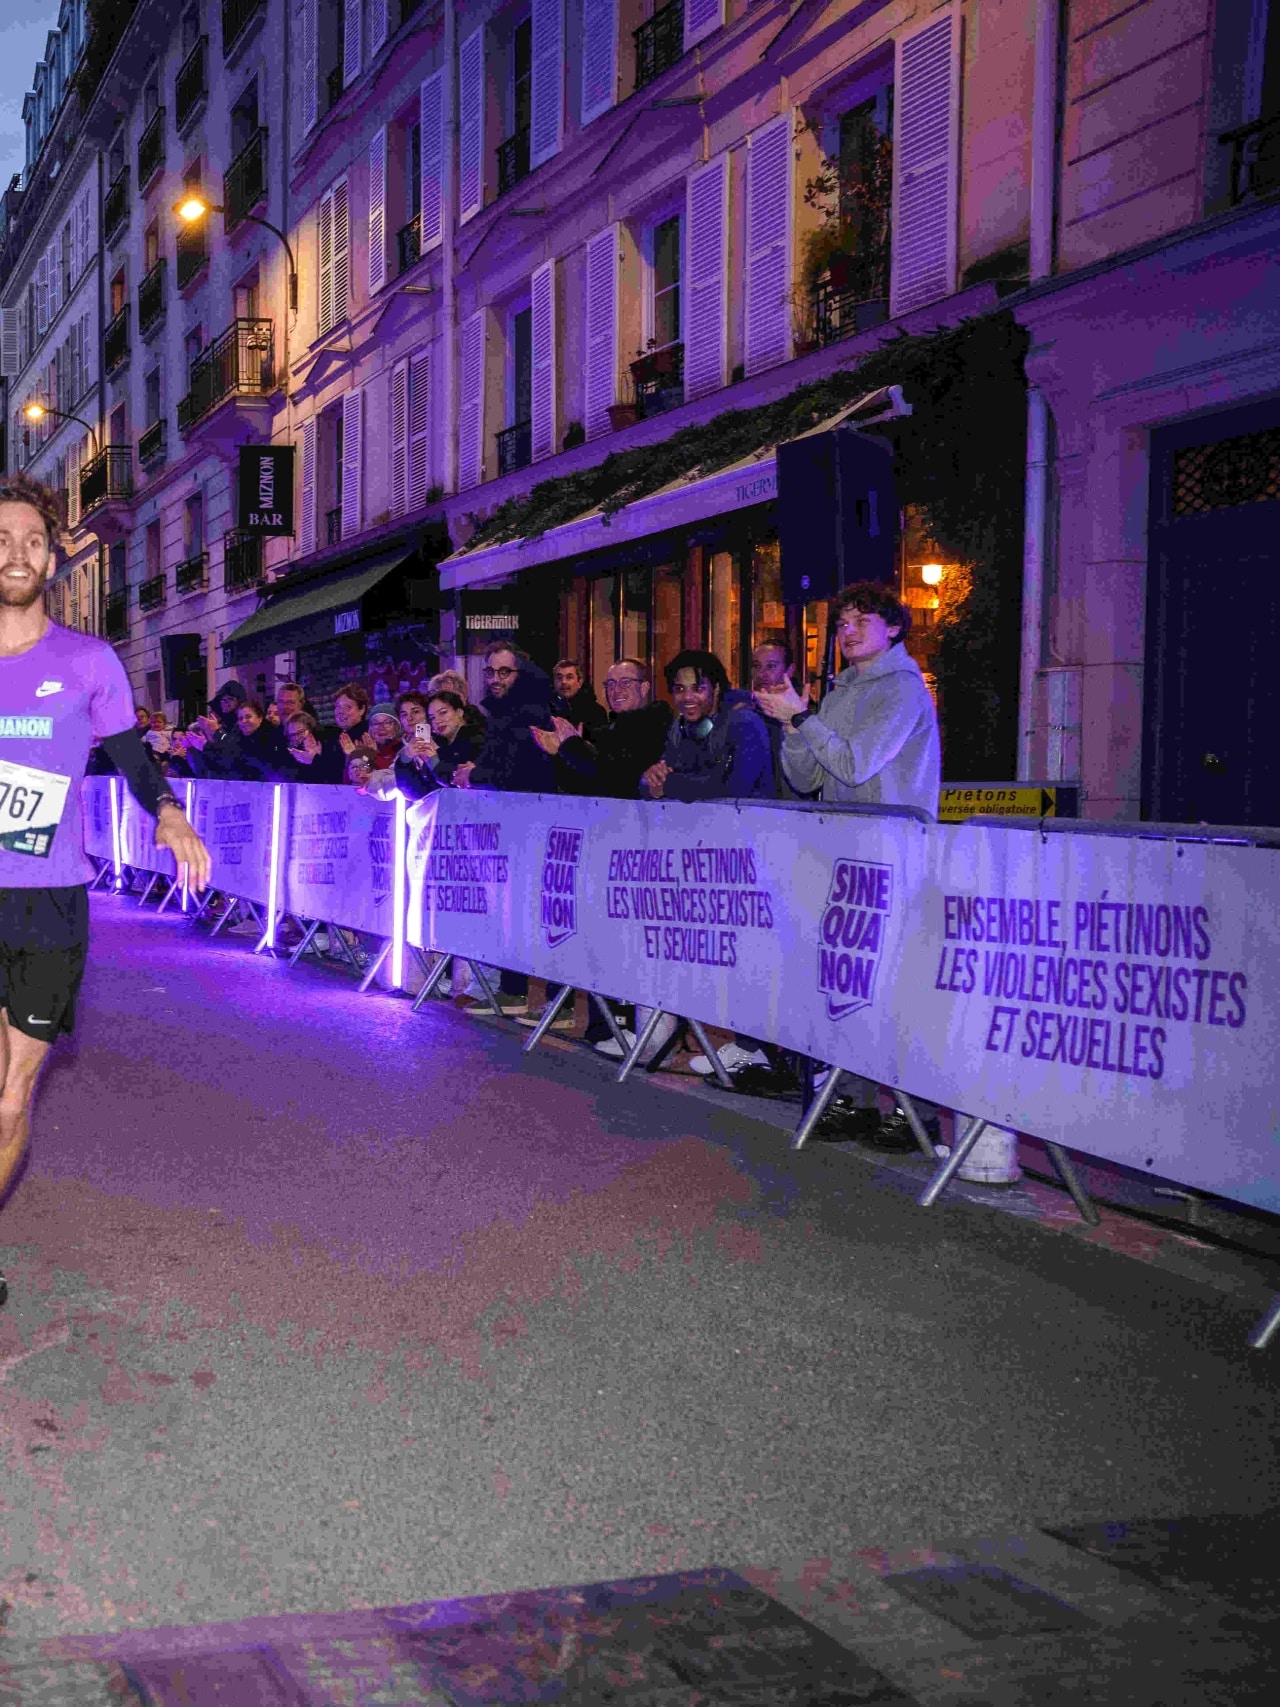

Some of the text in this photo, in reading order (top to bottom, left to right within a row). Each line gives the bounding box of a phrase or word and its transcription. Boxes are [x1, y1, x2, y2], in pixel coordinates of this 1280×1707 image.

[259, 456, 274, 509] MIZNON
[249, 513, 283, 526] BAR
[978, 803, 1037, 815] obligatoire
[546, 830, 582, 863] SINE
[608, 840, 758, 889] ENSEMBLE, PIÉTINONS
[437, 884, 488, 914] SEXUELLES
[543, 863, 575, 896] QUA
[831, 863, 890, 911] SINE
[542, 896, 575, 930] NON
[606, 886, 775, 929] LES VIOLENCES SEXISTES
[823, 904, 882, 954] QUA
[943, 889, 1211, 961] ENSEMBLE, PIÉTINONS
[644, 925, 738, 969] ET SEXUELLES
[820, 948, 876, 1000] NON
[934, 946, 1248, 1029] LES VIOLENCES SEXISTES
[985, 1004, 1168, 1080] ET SEXUELLES
